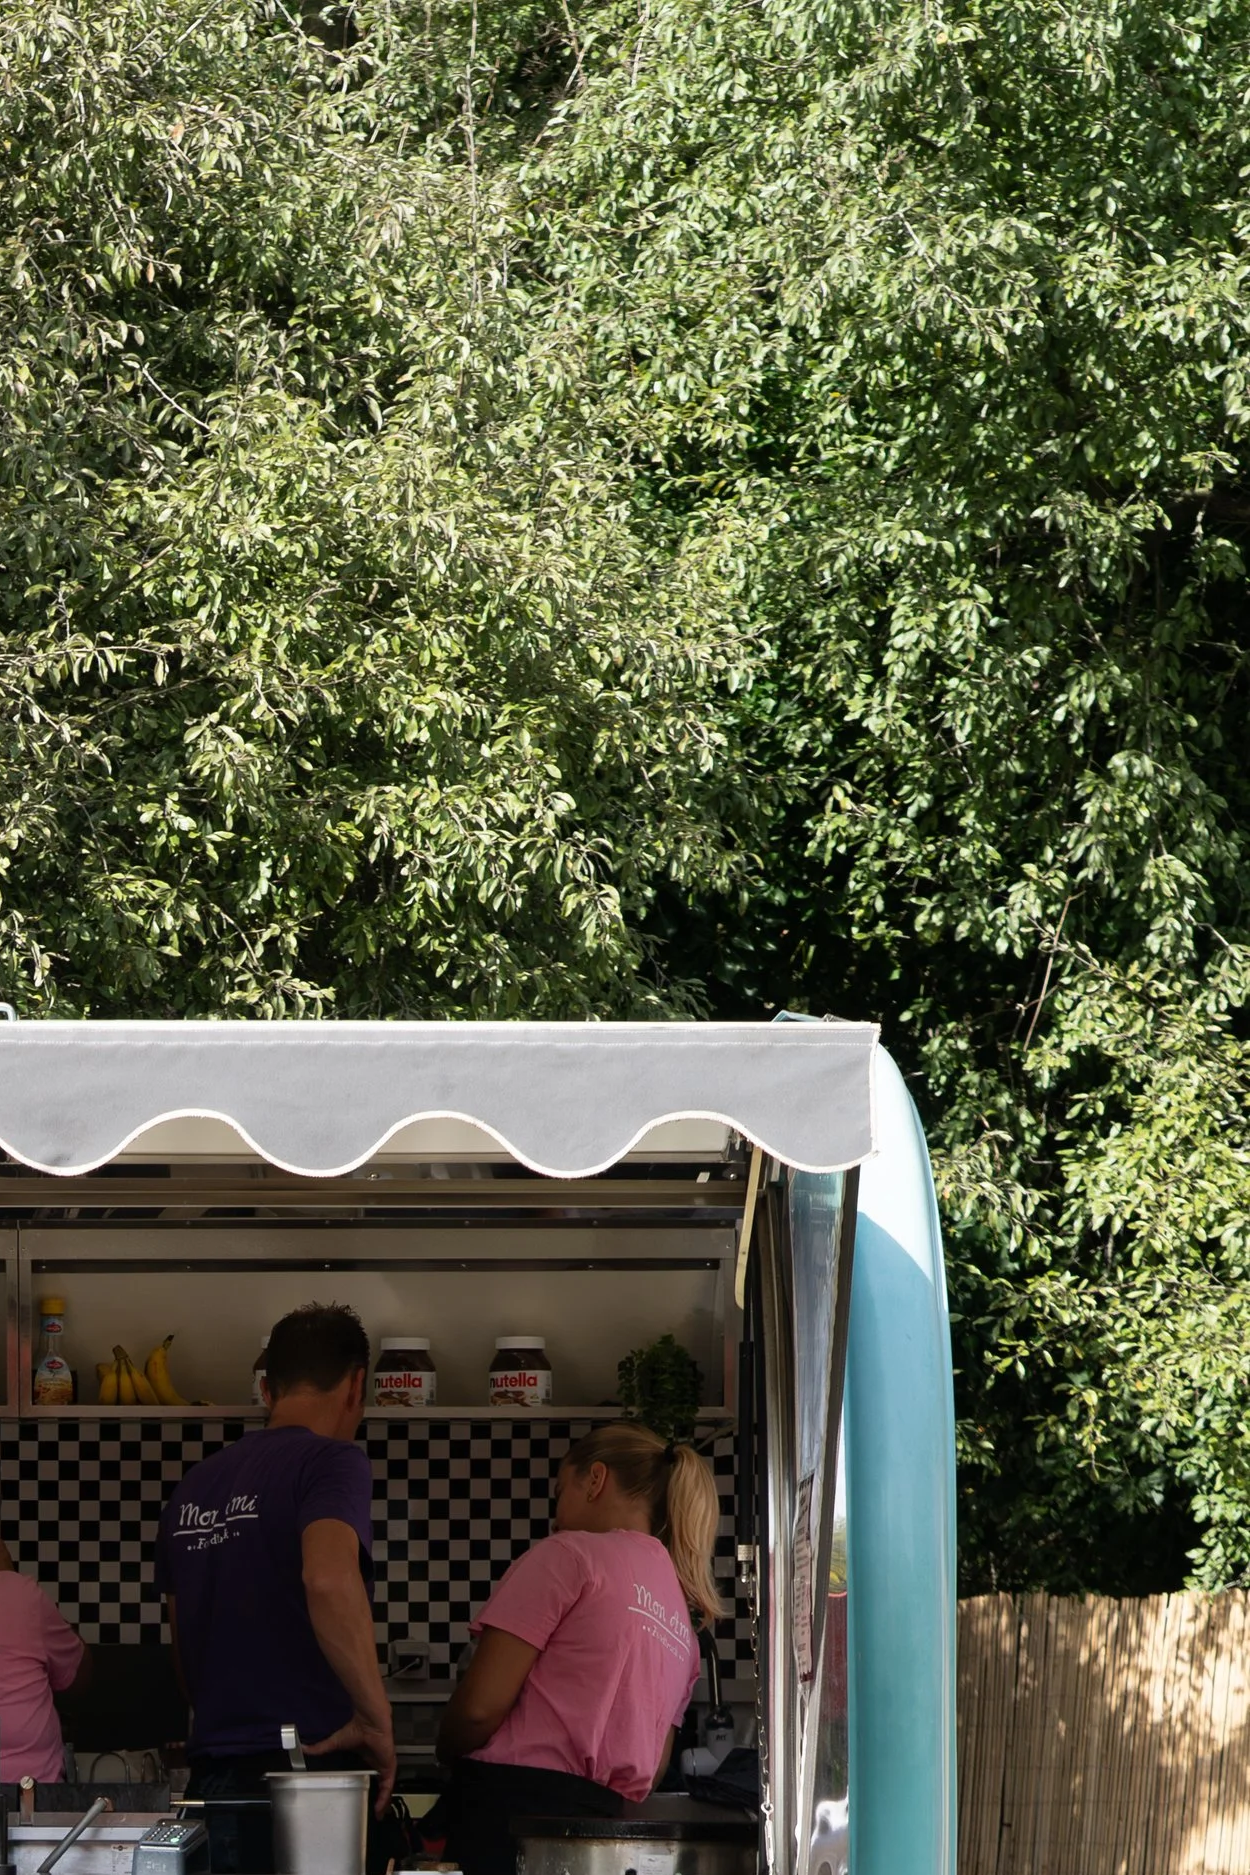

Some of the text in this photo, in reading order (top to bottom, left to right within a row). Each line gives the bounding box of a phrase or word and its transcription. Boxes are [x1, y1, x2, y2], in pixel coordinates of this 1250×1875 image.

[374, 1373, 422, 1388] nutella
[490, 1372, 537, 1388] nutella
[225, 1494, 258, 1515] mi
[633, 1583, 666, 1622] Mon
